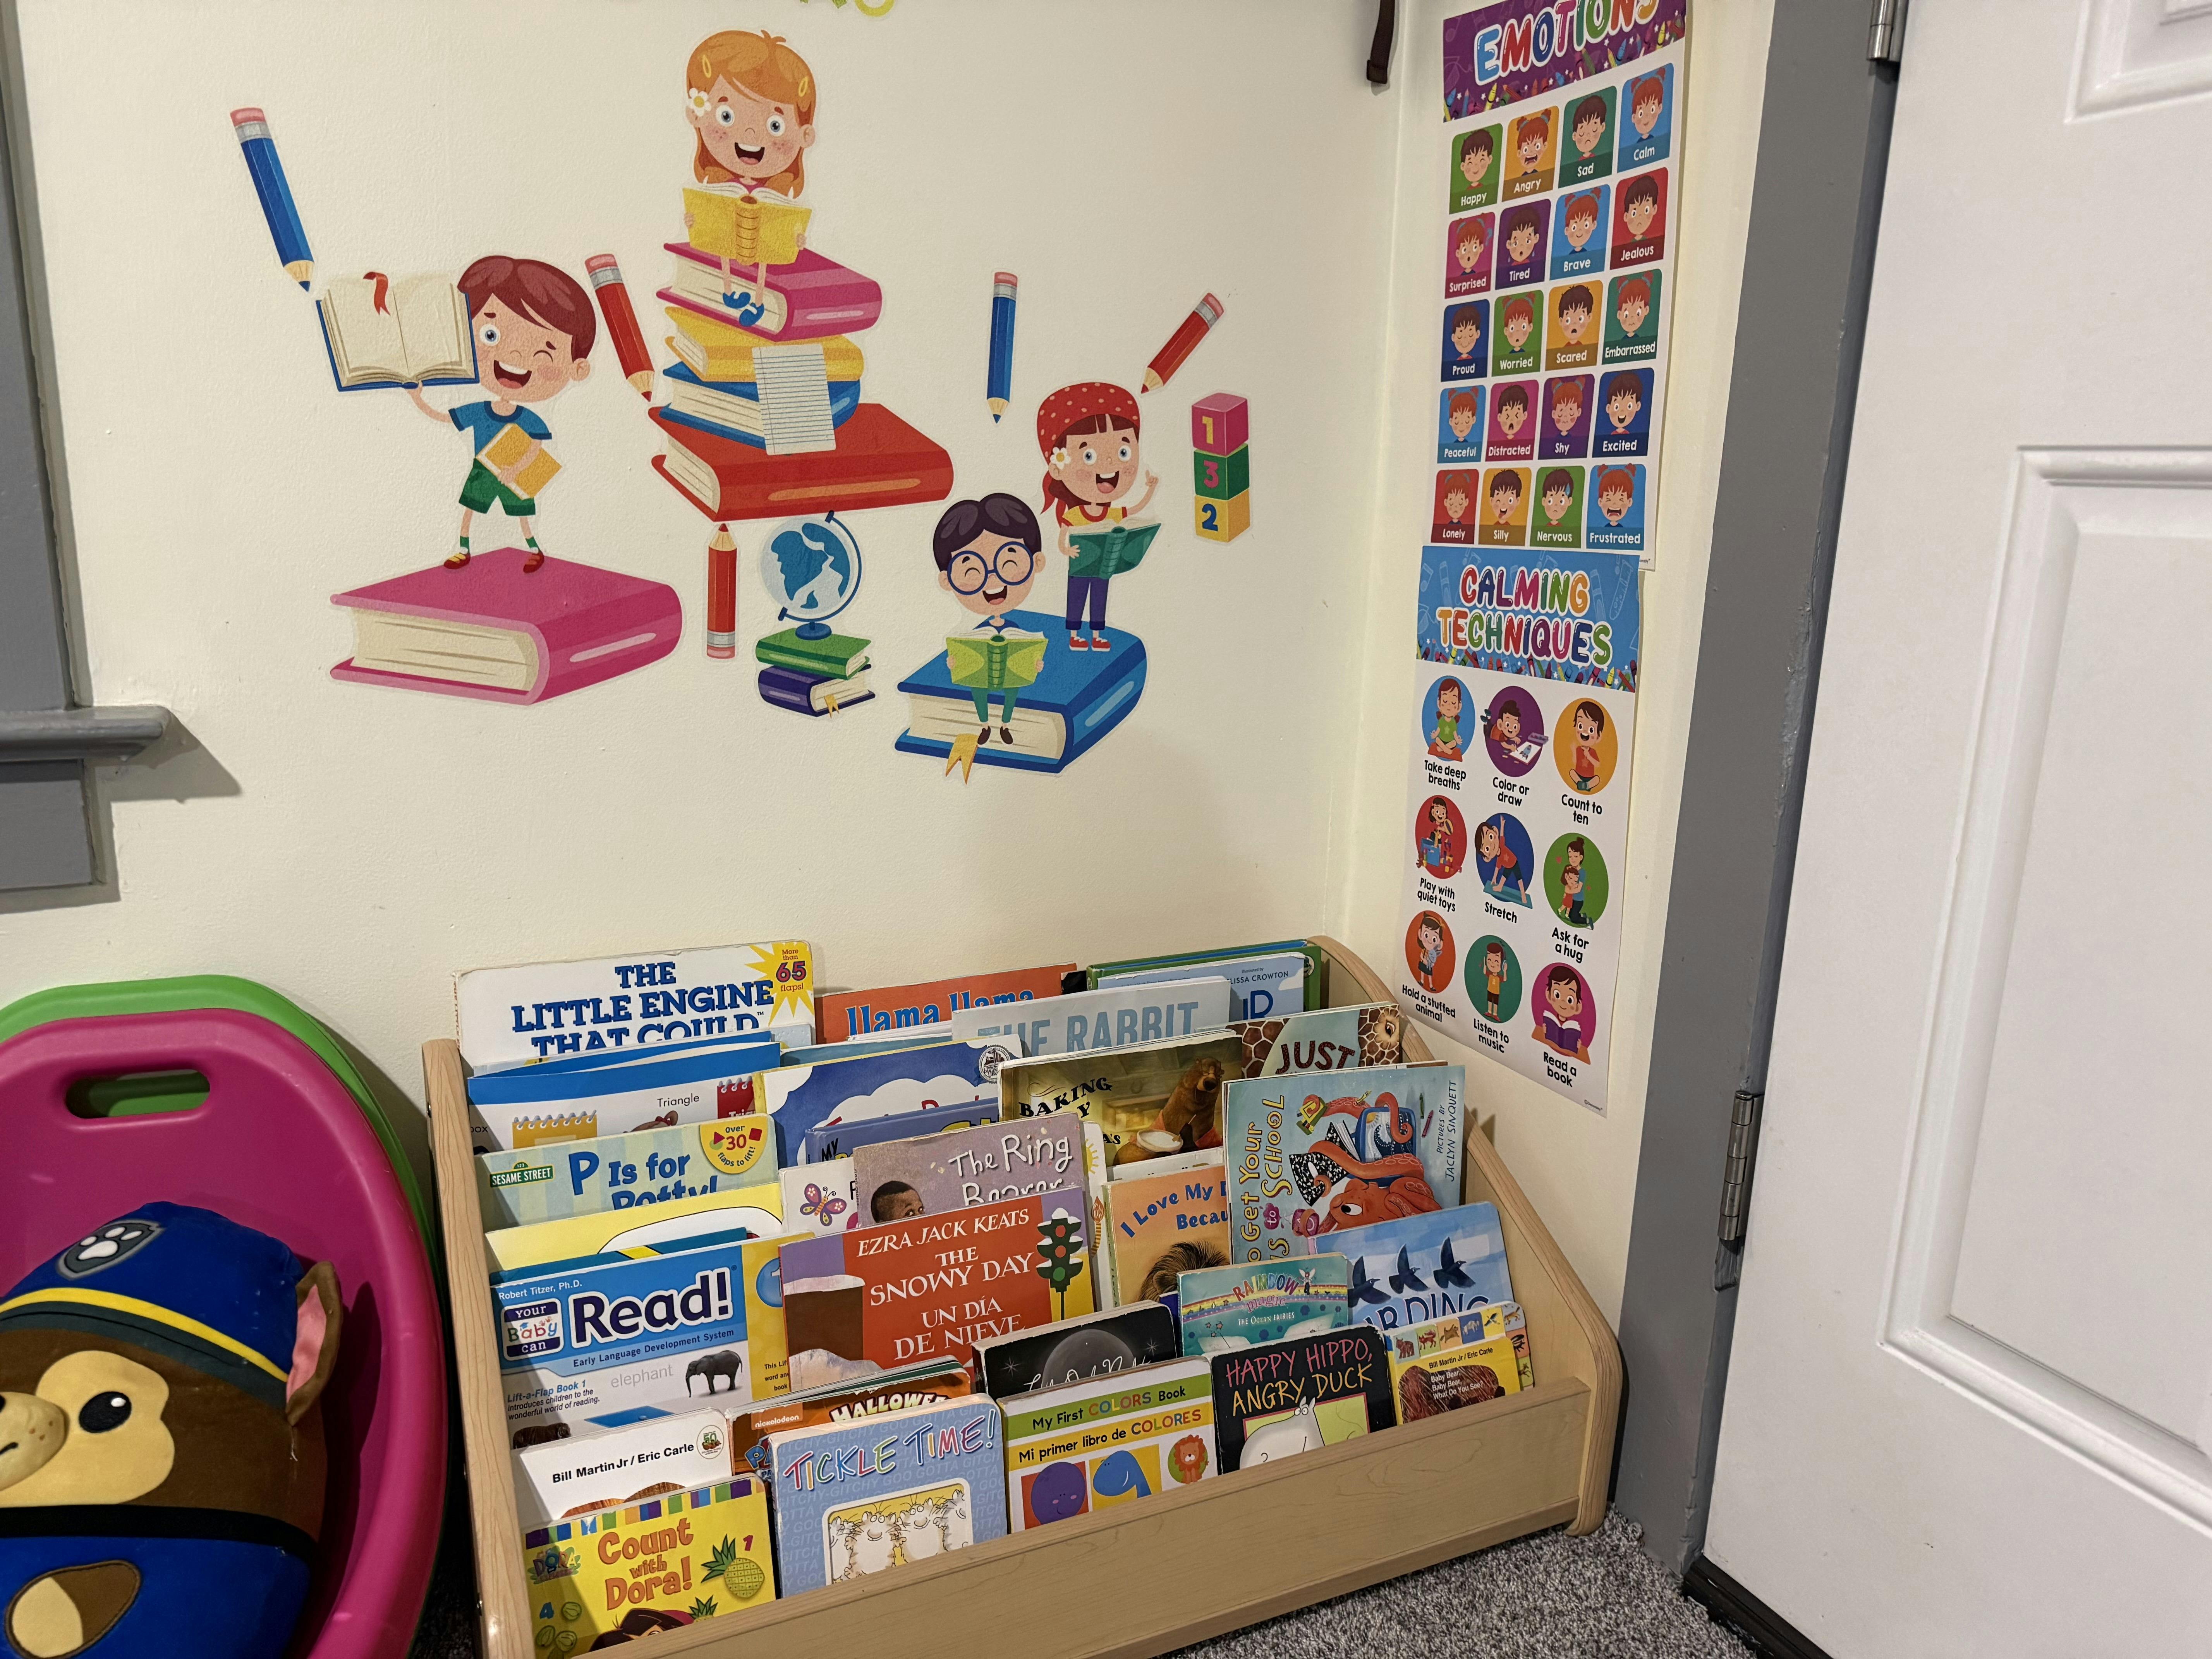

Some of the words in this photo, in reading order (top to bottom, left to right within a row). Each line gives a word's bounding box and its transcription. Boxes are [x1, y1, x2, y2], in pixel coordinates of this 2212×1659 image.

[1633, 146, 1655, 161] Calm
[1577, 163, 1594, 177] Sad
[1514, 178, 1541, 193] Angry
[1461, 192, 1487, 206] Happy
[1621, 246, 1654, 261] Jealous
[1510, 268, 1530, 281] Tired
[1564, 259, 1591, 271] Brave
[1449, 277, 1486, 292] Surprised
[1556, 350, 1587, 363] Scared
[1605, 342, 1656, 358] Embarrassed
[1453, 363, 1475, 375] Proud
[1500, 357, 1533, 369] Worried
[1202, 416, 1213, 444] 1
[1444, 447, 1476, 458] Peaceful
[1489, 445, 1531, 457] Distracted
[1555, 443, 1570, 455] Shy
[1602, 440, 1637, 452] Excited
[1204, 460, 1219, 488] 3
[1202, 503, 1218, 532] 2
[1443, 529, 1465, 539] Lonely
[1493, 530, 1509, 541] Silly
[1537, 531, 1572, 541] Nervous
[1590, 533, 1640, 544] Frustrated
[1460, 565, 1590, 617] CALMING
[1436, 607, 1613, 667] TECHNIQUES
[1424, 760, 1443, 774] Take
[1444, 766, 1466, 781] deep
[1428, 774, 1460, 790] breaths
[1492, 777, 1517, 792] Color
[1519, 784, 1529, 795] or
[1498, 792, 1522, 807] draw
[1561, 794, 1590, 811] Count
[1592, 802, 1602, 815] to
[1573, 811, 1589, 825] ten
[1420, 878, 1436, 892] Play
[1438, 886, 1455, 900] with
[1417, 890, 1437, 905] quiet
[1439, 898, 1456, 912] toys
[1484, 902, 1517, 923] Stretch
[1552, 927, 1570, 945] Ask
[1573, 935, 1589, 950] for
[1555, 944, 1562, 953] a
[1563, 946, 1583, 963] hug
[615, 962, 676, 989] THE
[776, 960, 807, 984] 65
[1252, 971, 1288, 981] CROWTON
[780, 982, 804, 993] flaps!
[511, 995, 632, 1033] LITTLE
[639, 980, 774, 1019] ENGINE
[1402, 984, 1420, 999] Hold
[1421, 994, 1427, 1003] a
[1428, 998, 1456, 1018] stuffed
[1415, 1003, 1443, 1022] animal
[1066, 1001, 1199, 1053] RABBIT
[1474, 1018, 1498, 1038] Listen
[1499, 1030, 1509, 1044] to
[1479, 1034, 1504, 1053] music
[1543, 1051, 1568, 1072] Read
[1570, 1066, 1577, 1077] a
[1547, 1066, 1573, 1087] book
[658, 1093, 699, 1108] Triangle
[1018, 1077, 1112, 1117] BAKING
[1447, 1080, 1456, 1134] SINQUETT
[1439, 1104, 1445, 1114] BY
[726, 1134, 747, 1150] 30
[1261, 1095, 1293, 1198] SCHOOL
[1437, 1120, 1445, 1154] PICTURES
[718, 1152, 734, 1167] flaps
[737, 1158, 744, 1166] to
[744, 1146, 756, 1160] lift!
[948, 1150, 998, 1177] The
[1001, 1134, 1073, 1173] Ring
[1239, 1121, 1262, 1185] Your
[1445, 1140, 1456, 1182] JACLYN
[492, 1172, 522, 1186] SESAME
[524, 1168, 551, 1180] STREET
[1240, 1192, 1261, 1242] Get
[1267, 1210, 1276, 1225] to
[857, 1231, 914, 1258] EZRA
[916, 1220, 967, 1245] JACK
[973, 1209, 1029, 1234] KEATS
[935, 1247, 979, 1267] THE
[499, 1290, 527, 1300] Robert
[530, 1286, 556, 1295] Titzer,
[559, 1280, 582, 1290] Ph.D.
[870, 1265, 973, 1307] SNOWY
[981, 1252, 1034, 1282] DAY
[1233, 1273, 1299, 1302] RAINBOW
[569, 1269, 732, 1348] Read!
[921, 1306, 956, 1329] UN
[963, 1296, 1003, 1320] DÍA
[1274, 1312, 1294, 1321] FAIRIES
[508, 1322, 557, 1342] Baby
[894, 1332, 935, 1360] DE
[944, 1314, 1026, 1348] NIEVE
[522, 1342, 547, 1353] can
[573, 1357, 596, 1368] Early
[599, 1347, 641, 1364] Language
[644, 1336, 701, 1353] Development
[704, 1329, 734, 1343] System
[1439, 1357, 1456, 1366] Martin
[1479, 1347, 1493, 1355] Carle
[1226, 1350, 1296, 1388] HAPPY
[1306, 1338, 1372, 1373] HIPPO,
[611, 1364, 673, 1389] elephant
[1431, 1374, 1445, 1382] Baby
[1446, 1370, 1461, 1379] Bear,
[508, 1389, 553, 1403] Lift-a-Flap
[557, 1382, 578, 1393] Book
[1233, 1377, 1305, 1417] ANGRY
[1316, 1363, 1373, 1398] DUCK
[1433, 1392, 1448, 1400] What
[1470, 1381, 1483, 1390] See?
[508, 1398, 544, 1411] introduces
[546, 1393, 573, 1404] children
[508, 1407, 542, 1420] wonderful
[544, 1404, 563, 1413] world
[574, 1396, 600, 1408] reading.
[1032, 1417, 1053, 1431] My
[1057, 1408, 1084, 1424] First
[1089, 1391, 1152, 1416] COLORS
[1158, 1385, 1185, 1401] Book
[755, 1415, 799, 1427] nickelodeon
[1018, 1448, 1034, 1463] Mi
[1039, 1440, 1078, 1462] primer
[1082, 1434, 1108, 1447] libro
[1111, 1428, 1127, 1440] de
[1131, 1408, 1201, 1435] COLORES
[783, 1436, 898, 1490] TICKLE
[903, 1408, 996, 1465] TIME!
[553, 1471, 572, 1483] Bill
[576, 1462, 615, 1478] Martin
[616, 1458, 630, 1469] Jr
[637, 1450, 661, 1464] Eric
[663, 1443, 695, 1457] Carle
[597, 1518, 694, 1565] Count
[629, 1554, 668, 1580] with
[605, 1557, 692, 1611] Dora!
